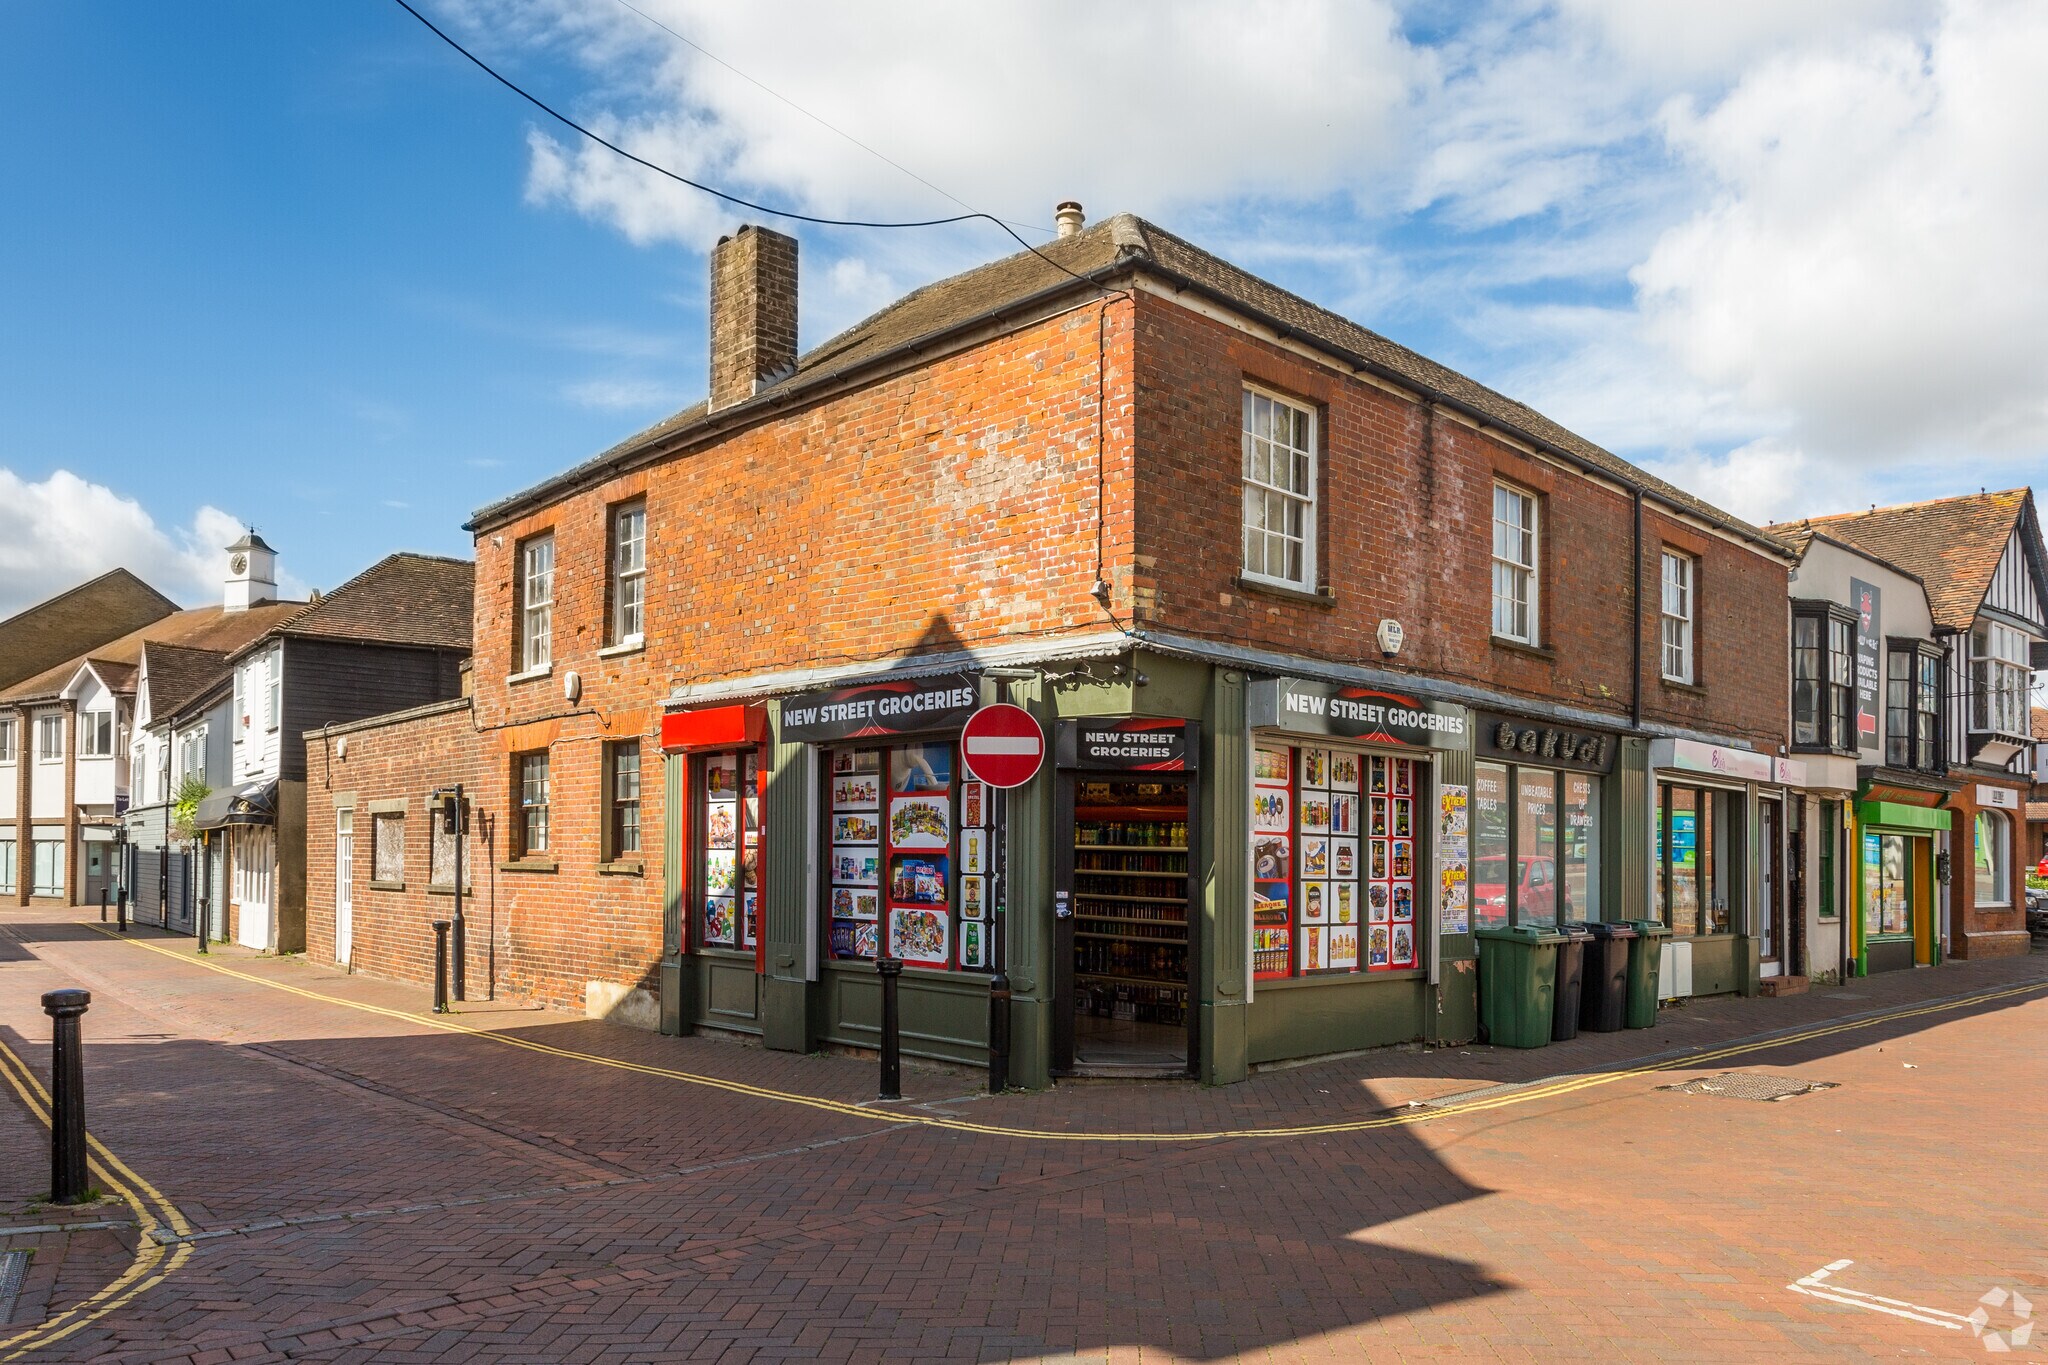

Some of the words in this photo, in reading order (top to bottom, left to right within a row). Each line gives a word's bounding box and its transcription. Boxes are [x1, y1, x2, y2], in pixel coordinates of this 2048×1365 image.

[1859, 689, 1872, 701] HERE
[785, 707, 817, 727] NEW
[820, 700, 876, 723] STREET
[879, 687, 973, 716] GROCERIES
[1286, 693, 1326, 715] NEW
[1330, 699, 1385, 723] STREET
[1388, 708, 1464, 734] GROCERIES
[1085, 732, 1120, 743] NEW
[1122, 733, 1176, 744] STREET
[1090, 746, 1170, 757] GROCERIES
[1476, 778, 1497, 793] COFFEE
[1520, 784, 1552, 799] UNBEATABLE
[1573, 781, 1591, 794] CHESTS
[1477, 797, 1497, 811] TABLES
[1527, 802, 1546, 815] PRICES
[1578, 799, 1585, 810] OF
[1570, 814, 1593, 827] DRAWERS
